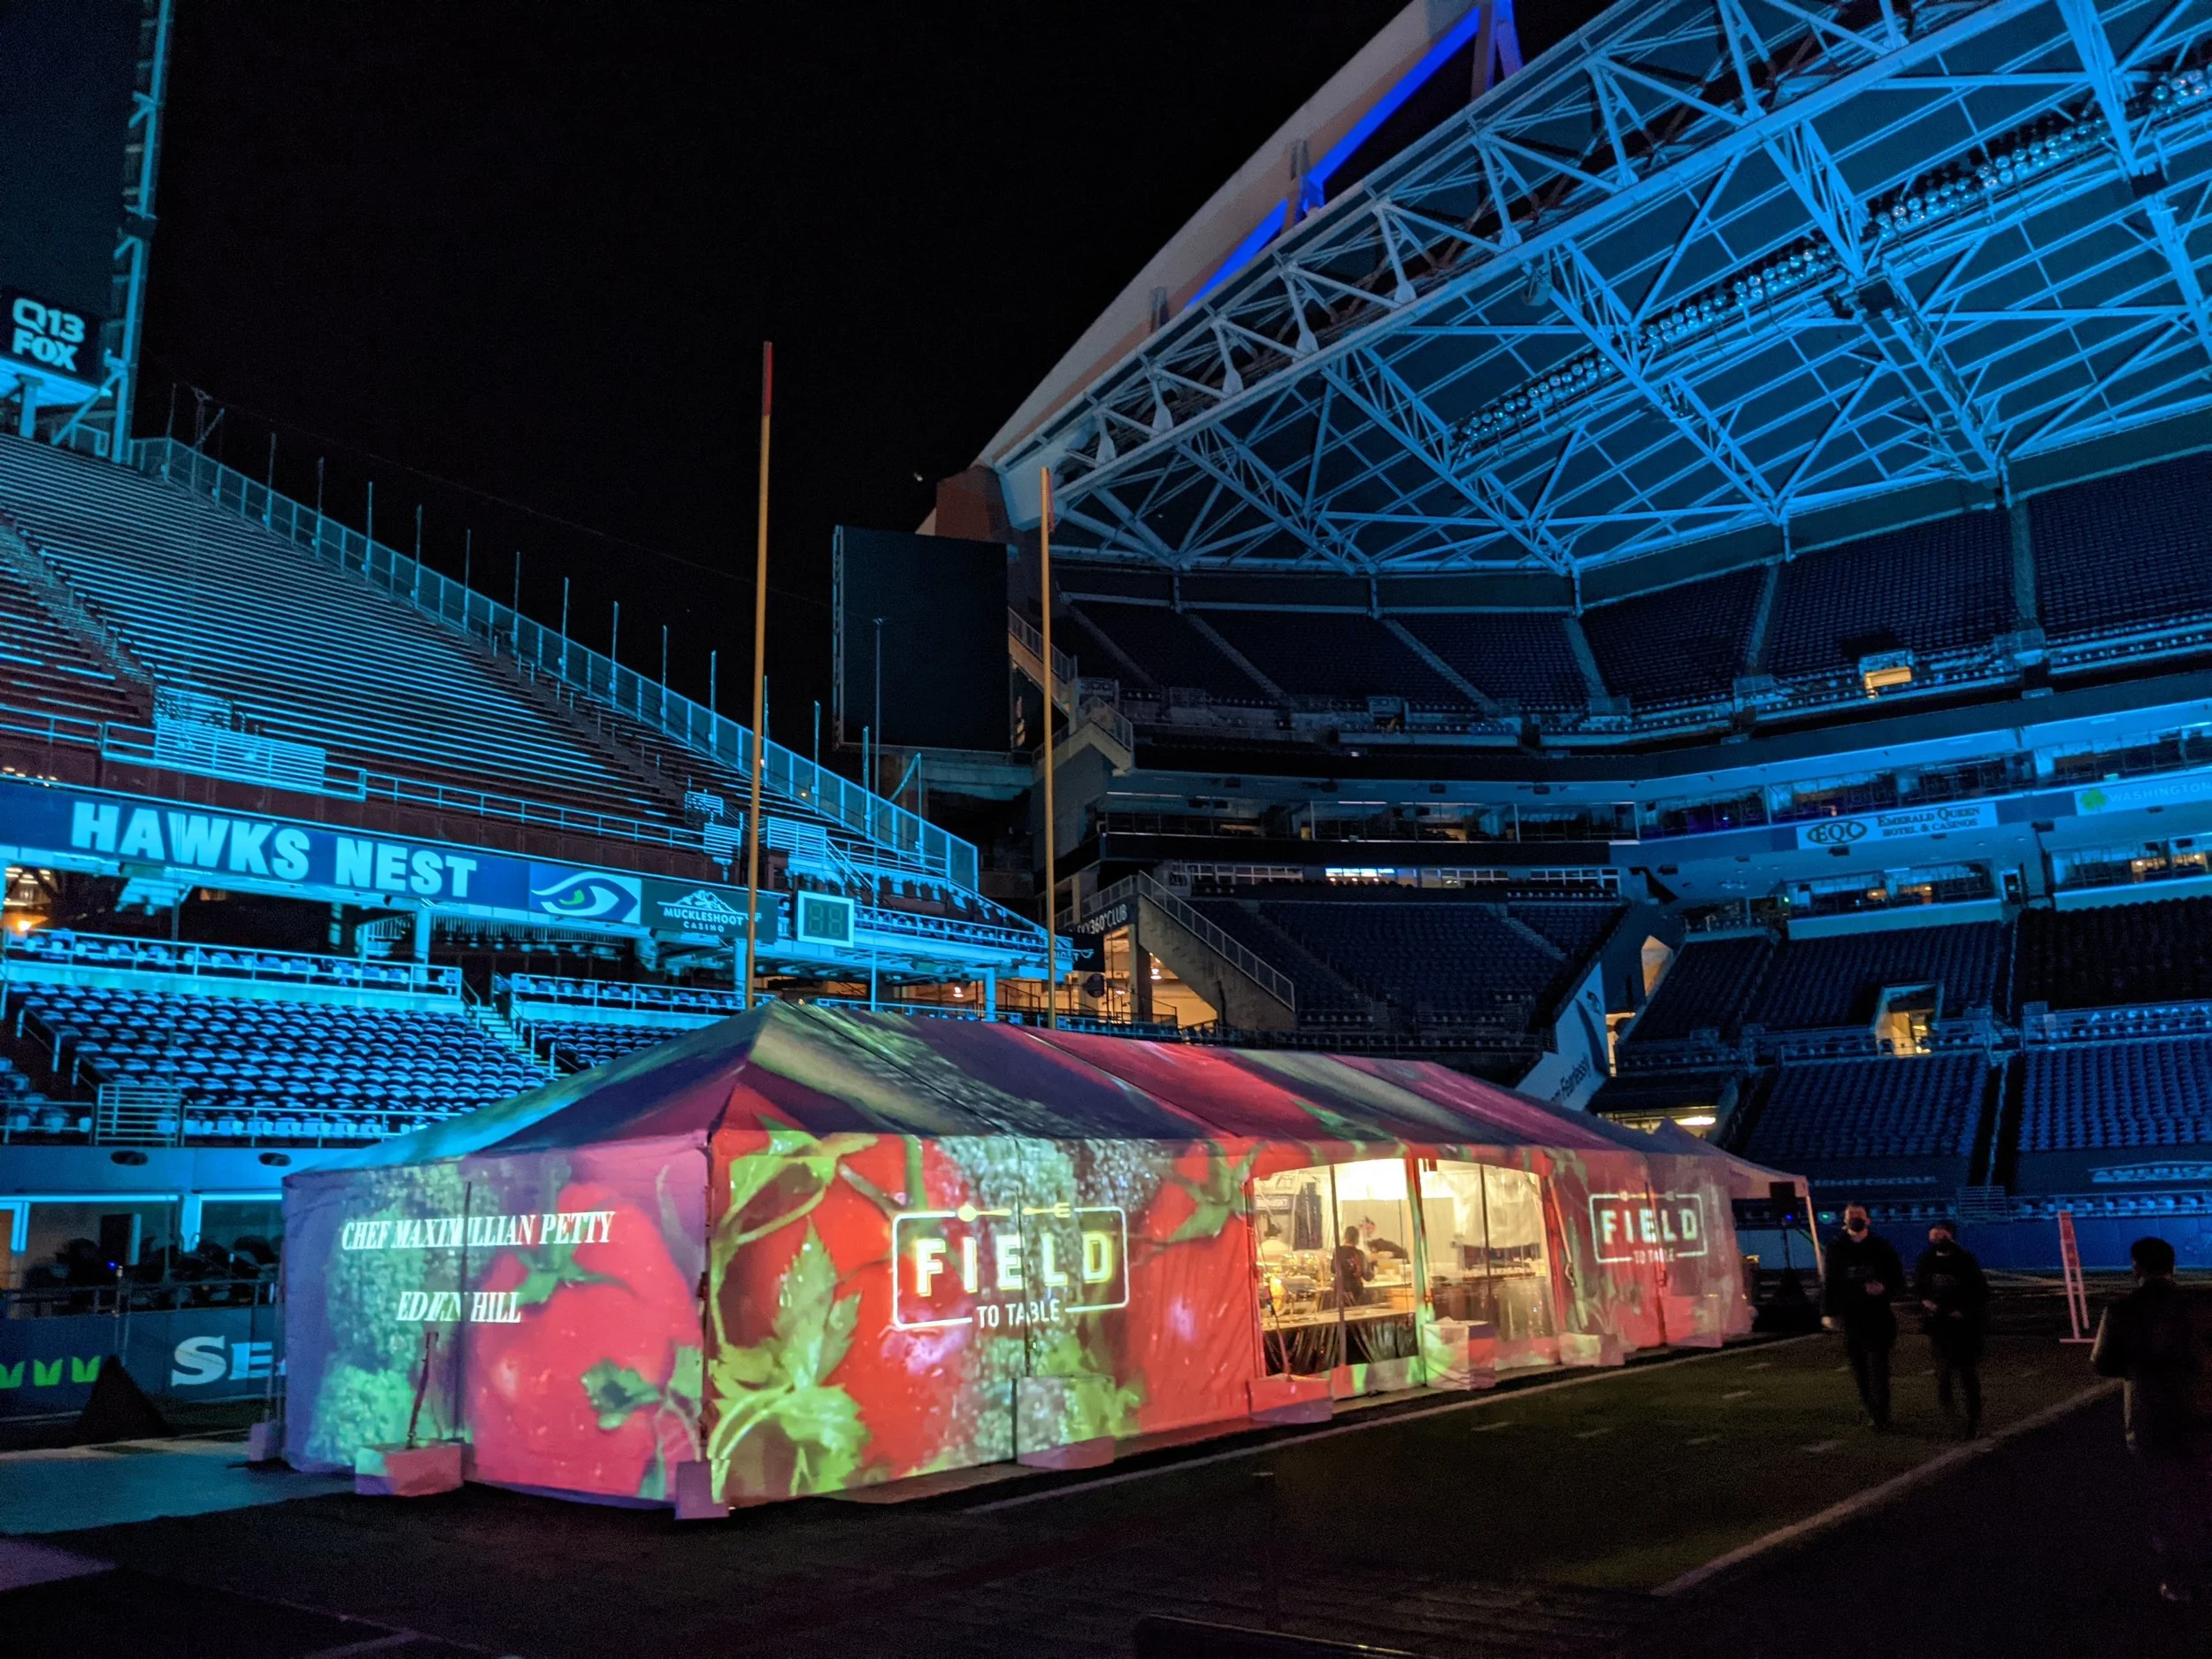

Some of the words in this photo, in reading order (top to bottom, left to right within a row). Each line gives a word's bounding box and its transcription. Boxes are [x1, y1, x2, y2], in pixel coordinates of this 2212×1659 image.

[12, 297, 86, 343] Q13
[12, 327, 81, 372] FOX
[1812, 823, 1863, 841] EQC
[1877, 811, 1934, 827] EMERALD
[71, 801, 311, 881] HAWKS
[334, 837, 478, 898] NEST
[663, 906, 744, 926] MUCKLESHOOT
[682, 920, 725, 933] CASINO
[342, 1220, 391, 1250] CHEF
[390, 1214, 532, 1248] MAXIMILLIAN
[538, 1210, 616, 1245] PETTY
[1601, 1209, 1698, 1244] FIELD
[914, 1231, 1114, 1297] FIELD
[470, 1292, 522, 1323] HILL
[977, 1305, 1000, 1328] TO
[1004, 1298, 1061, 1325] TABLE
[171, 1335, 286, 1387] SE
